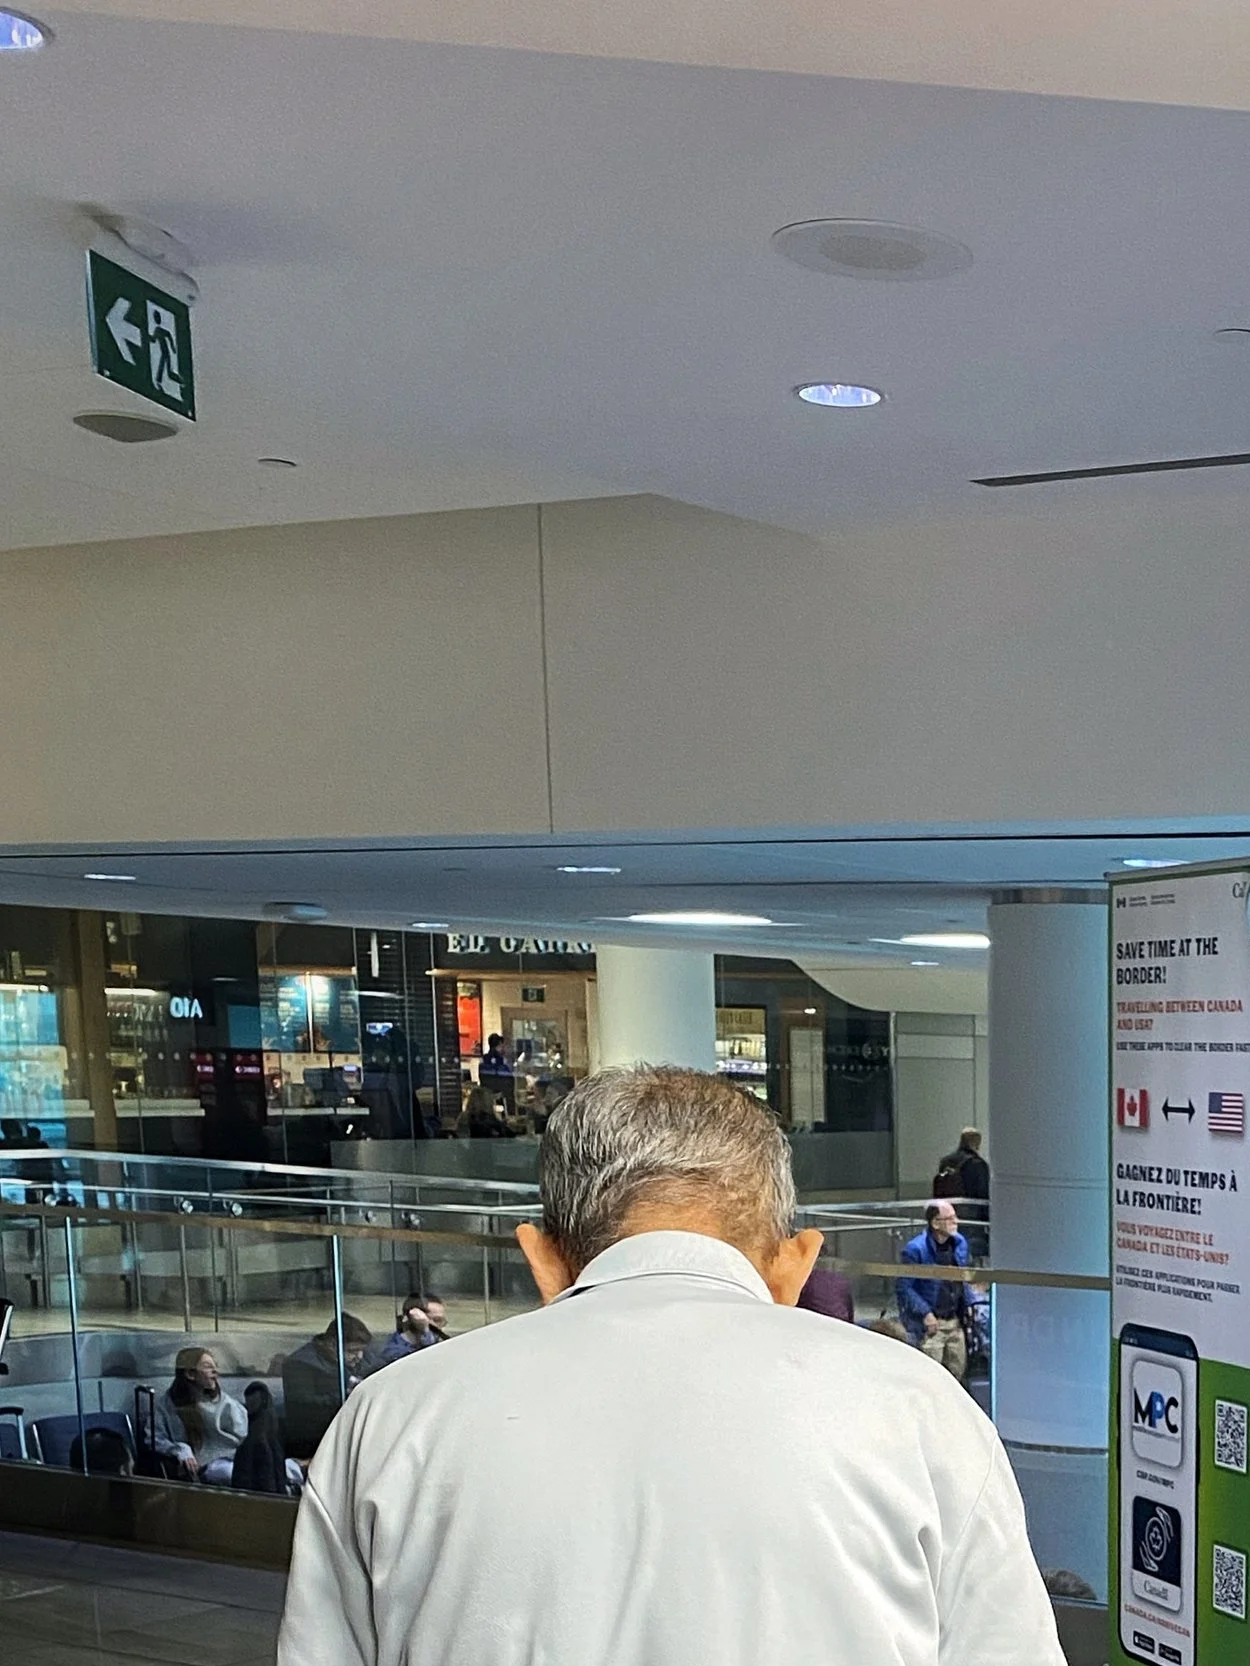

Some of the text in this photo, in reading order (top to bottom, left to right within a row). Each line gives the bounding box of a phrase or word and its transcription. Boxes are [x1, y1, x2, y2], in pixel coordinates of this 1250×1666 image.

[1116, 937, 1218, 960] SAVE TIME AT THE
[1116, 966, 1167, 985] BORDER!
[1117, 999, 1243, 1014] TRAVELLING BETWEEN CANADA
[1117, 1018, 1154, 1030] AND USA?
[1147, 1042, 1164, 1051] APPS
[1165, 1042, 1173, 1051] TO
[1194, 1042, 1207, 1052] THE
[1209, 1042, 1233, 1052] BORDER
[1116, 1163, 1238, 1192] GAGNEZ DU TEMPS À
[1116, 1188, 1202, 1216] LA FRONTIÈRE!
[1116, 1221, 1214, 1246] VOUS VOYAGEZ ENTRE LE
[1116, 1238, 1148, 1252] CANADA
[1150, 1242, 1160, 1254] ET
[1162, 1244, 1175, 1257] LES
[1141, 1269, 1153, 1278] CES
[1155, 1270, 1196, 1287] APPLICATIONS
[1197, 1278, 1215, 1290] POUR
[1133, 1388, 1179, 1434] MPC
